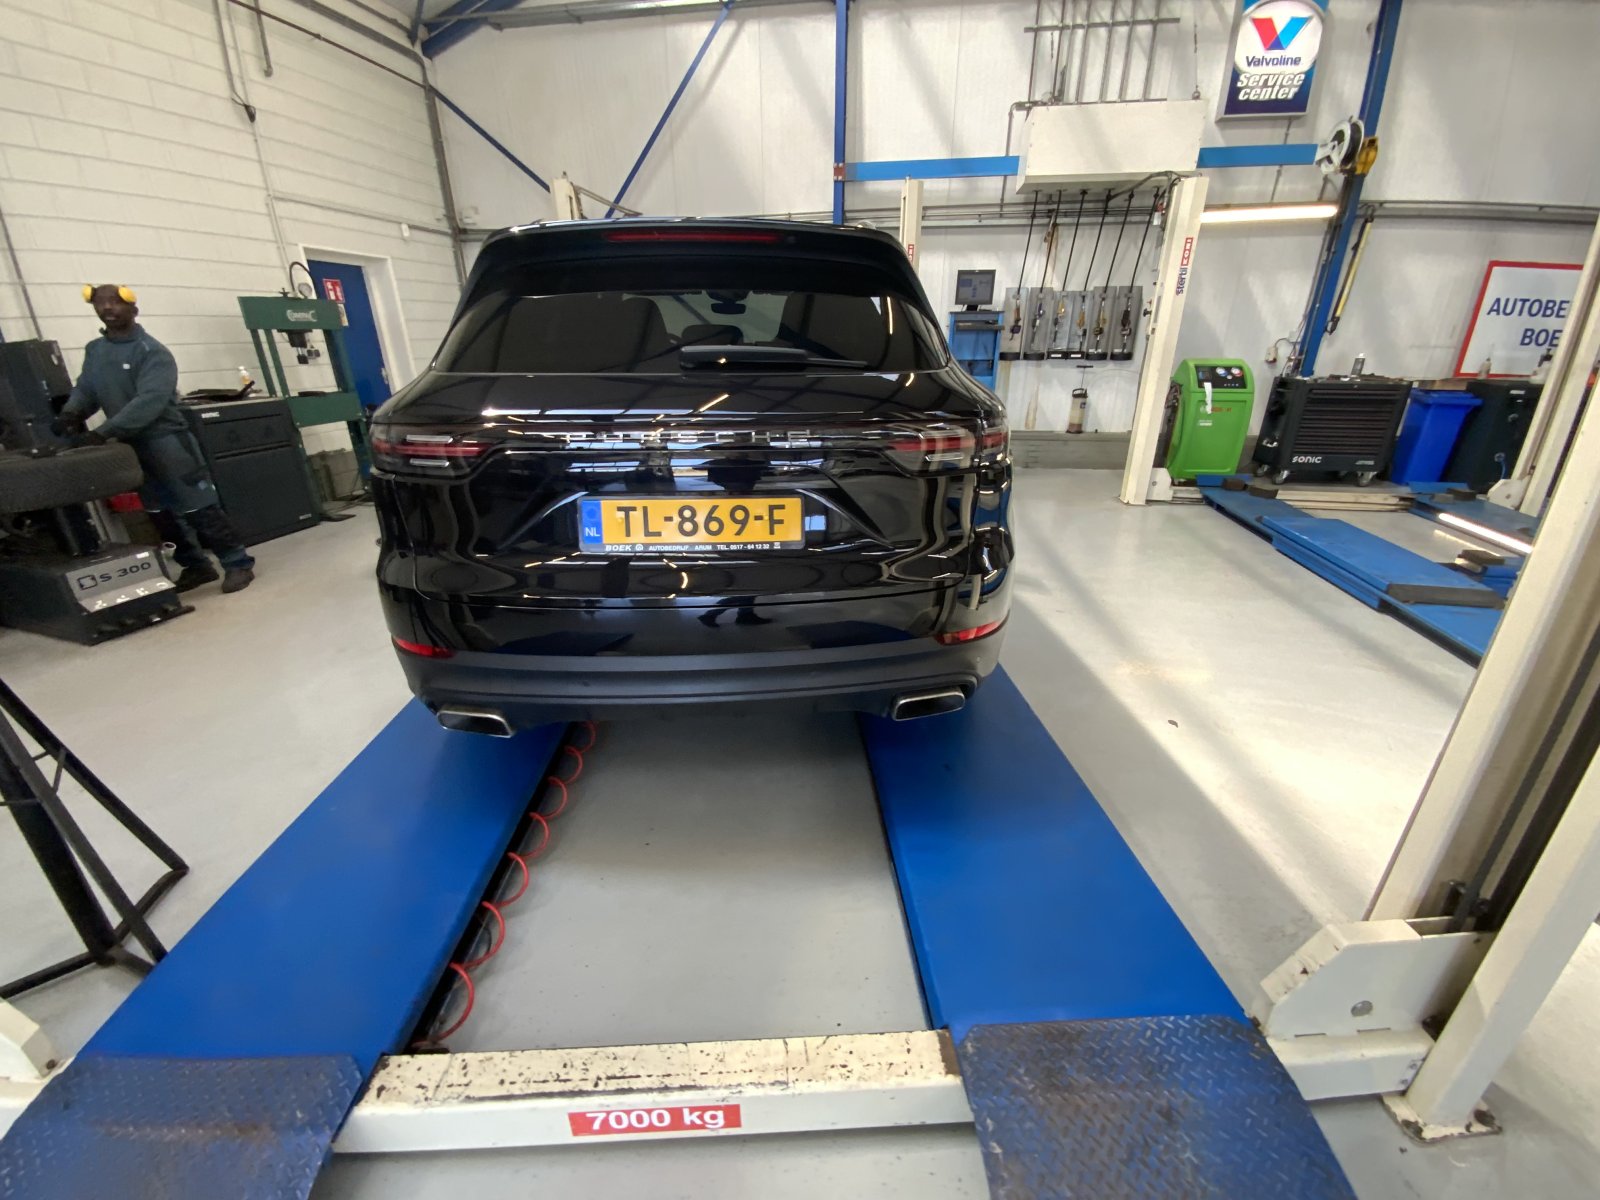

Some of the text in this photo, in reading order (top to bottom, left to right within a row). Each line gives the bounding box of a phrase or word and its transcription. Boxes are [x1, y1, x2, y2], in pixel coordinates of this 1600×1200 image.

[1246, 55, 1301, 67] Valvoline
[1237, 73, 1305, 88] Service
[1238, 86, 1298, 100] center
[1176, 238, 1192, 296] stertil KONI
[1487, 298, 1569, 318] AUTOBE
[1520, 328, 1562, 347] BOE
[616, 504, 786, 537] TL-869-F
[585, 527, 600, 537] NL
[605, 544, 632, 552] BOEK
[99, 562, 151, 583] S 300
[586, 1106, 725, 1130] 7000 kg
